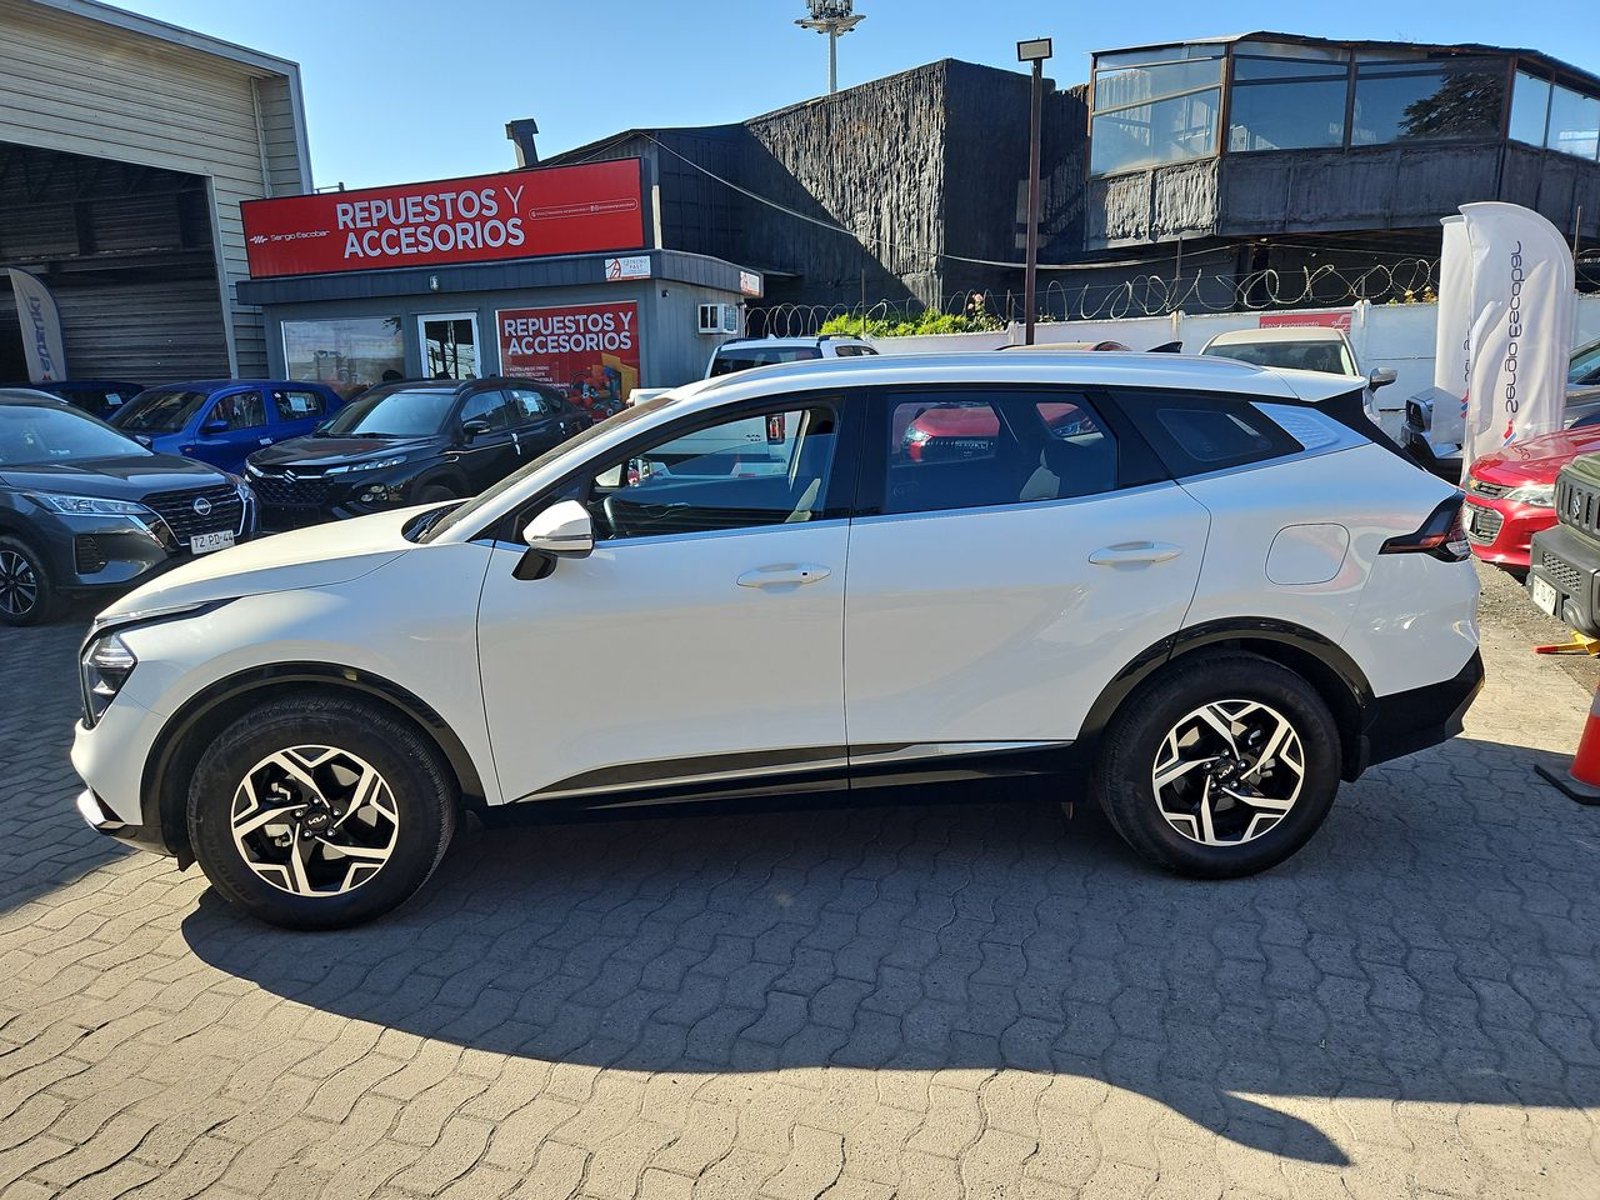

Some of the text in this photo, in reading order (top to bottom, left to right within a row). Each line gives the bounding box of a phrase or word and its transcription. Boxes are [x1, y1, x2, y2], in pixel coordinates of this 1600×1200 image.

[336, 185, 524, 230] REPUESTOS Y
[344, 217, 525, 259] ACCESORIOS
[504, 311, 633, 337] REPUESTOS Y
[508, 331, 632, 355] ACCESORIOS
